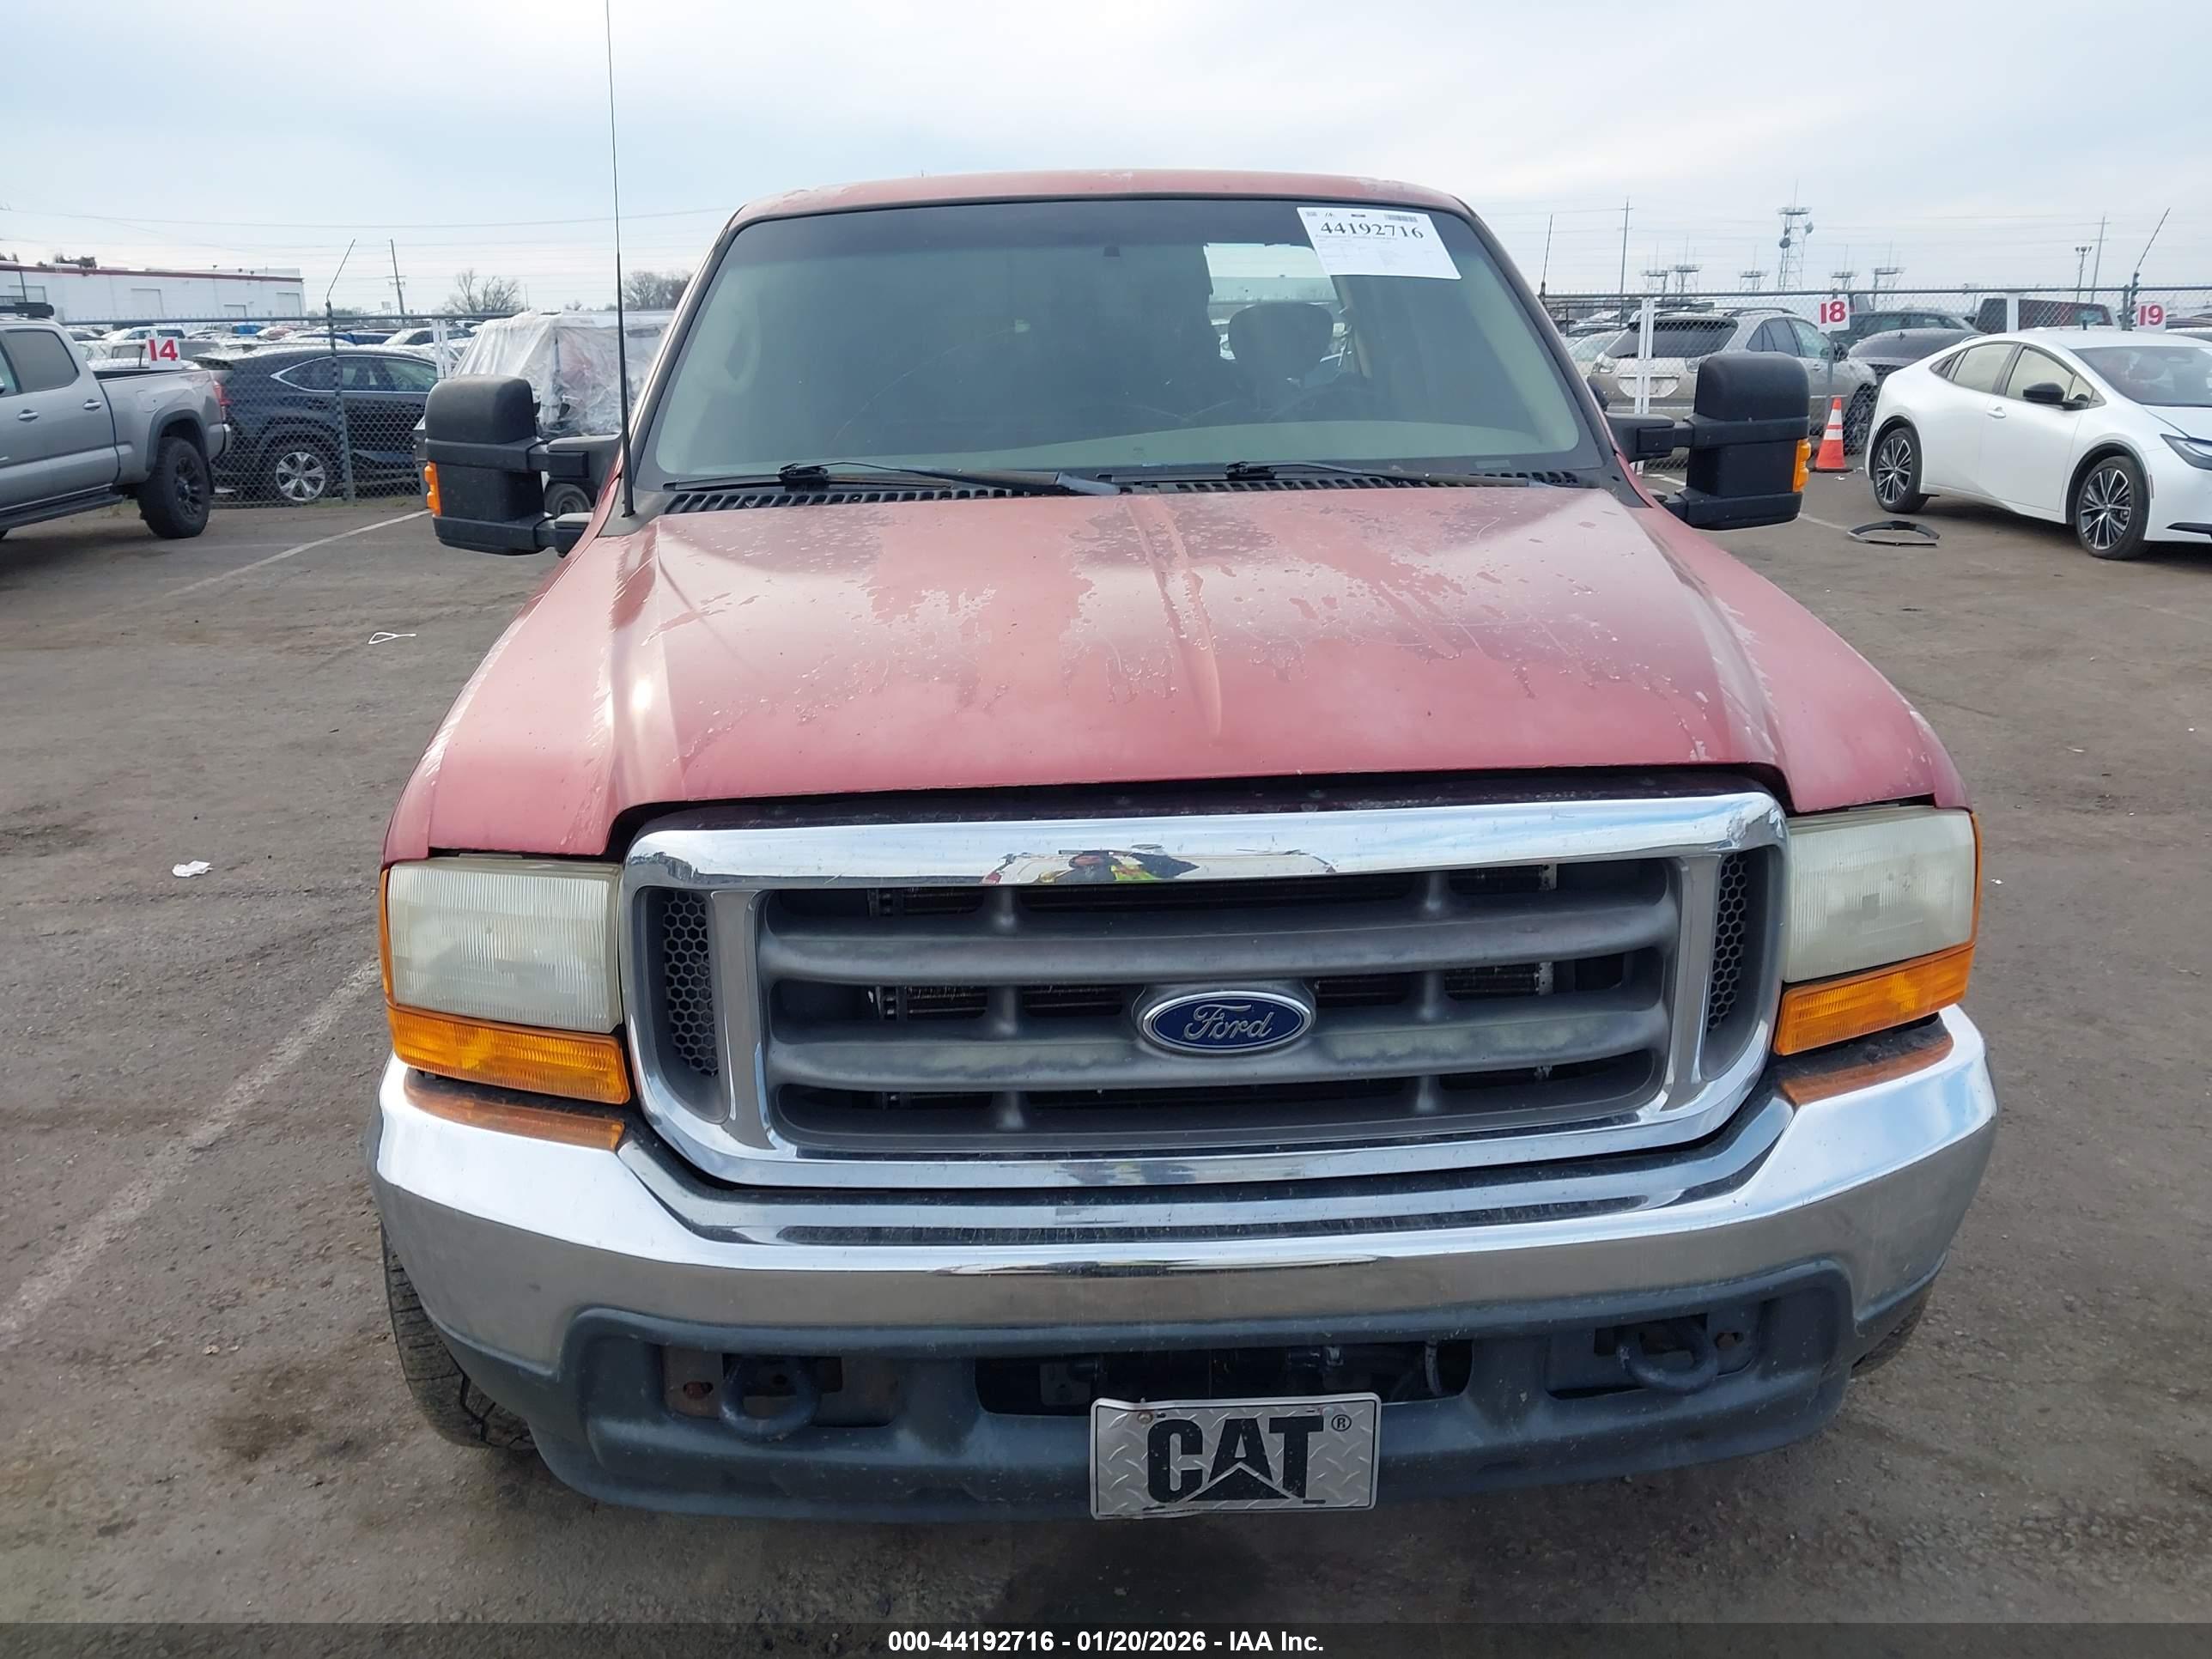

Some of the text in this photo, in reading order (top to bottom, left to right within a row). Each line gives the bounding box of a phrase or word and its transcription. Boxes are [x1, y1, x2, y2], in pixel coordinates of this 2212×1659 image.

[1320, 221, 1425, 240] 44192716
[1820, 301, 1846, 325] 18
[2139, 304, 2164, 326] 19
[148, 338, 179, 362] 14
[1182, 1003, 1275, 1042] Ford
